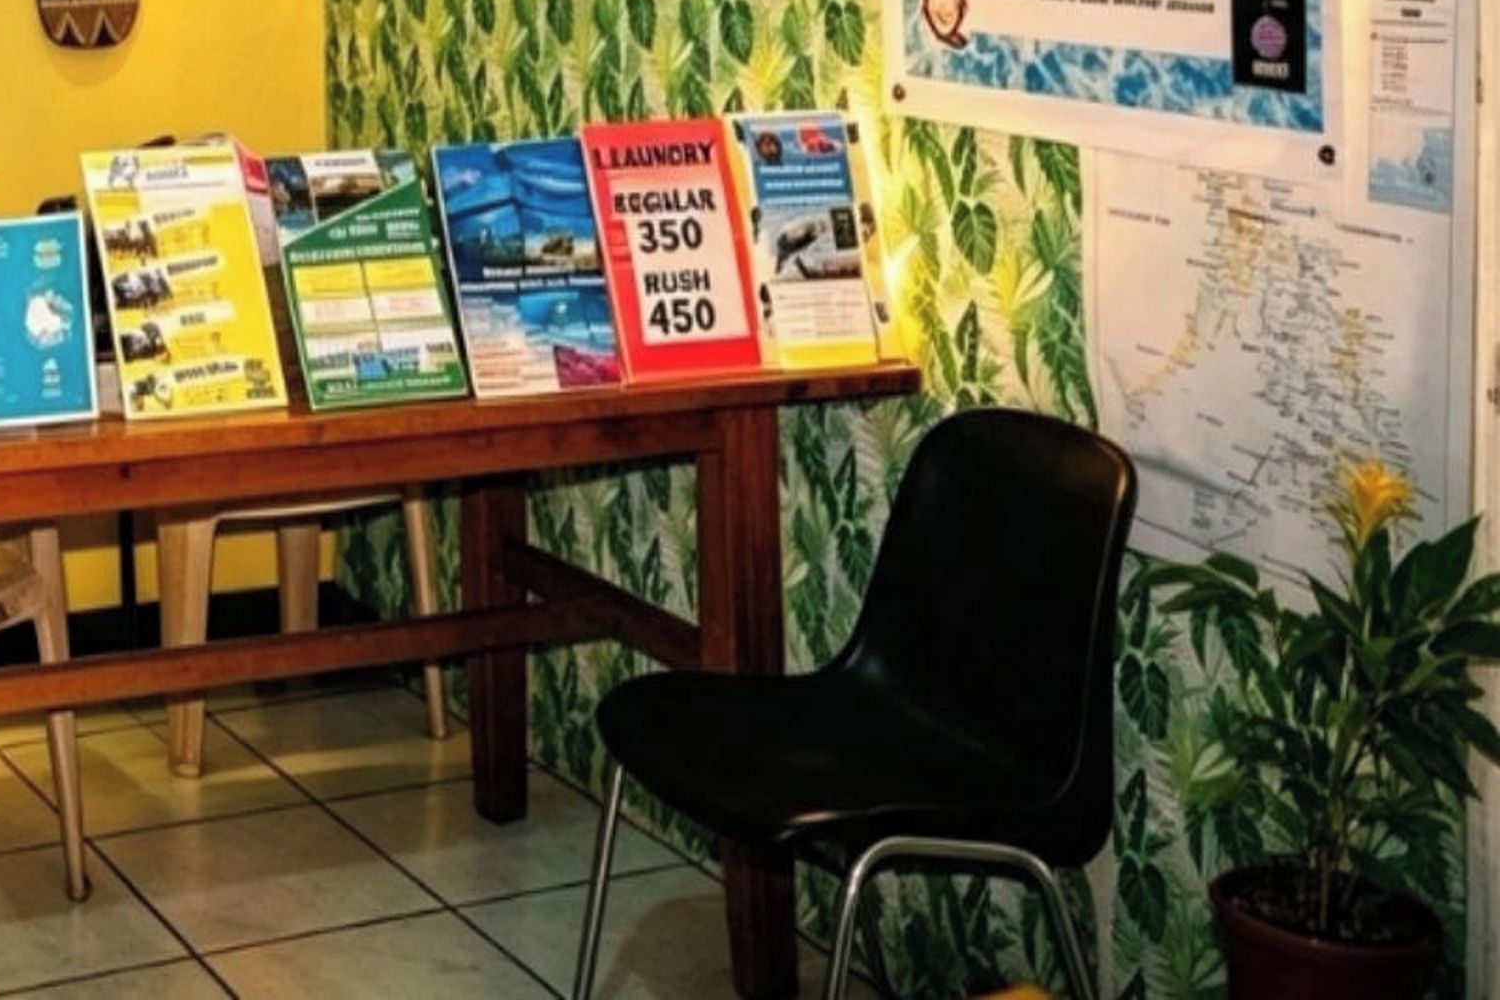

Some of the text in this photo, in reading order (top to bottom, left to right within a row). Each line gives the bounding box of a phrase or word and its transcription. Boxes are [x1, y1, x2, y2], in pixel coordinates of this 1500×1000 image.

[638, 218, 703, 254] 350
[644, 269, 711, 295] RUSH
[649, 298, 716, 336] 450
